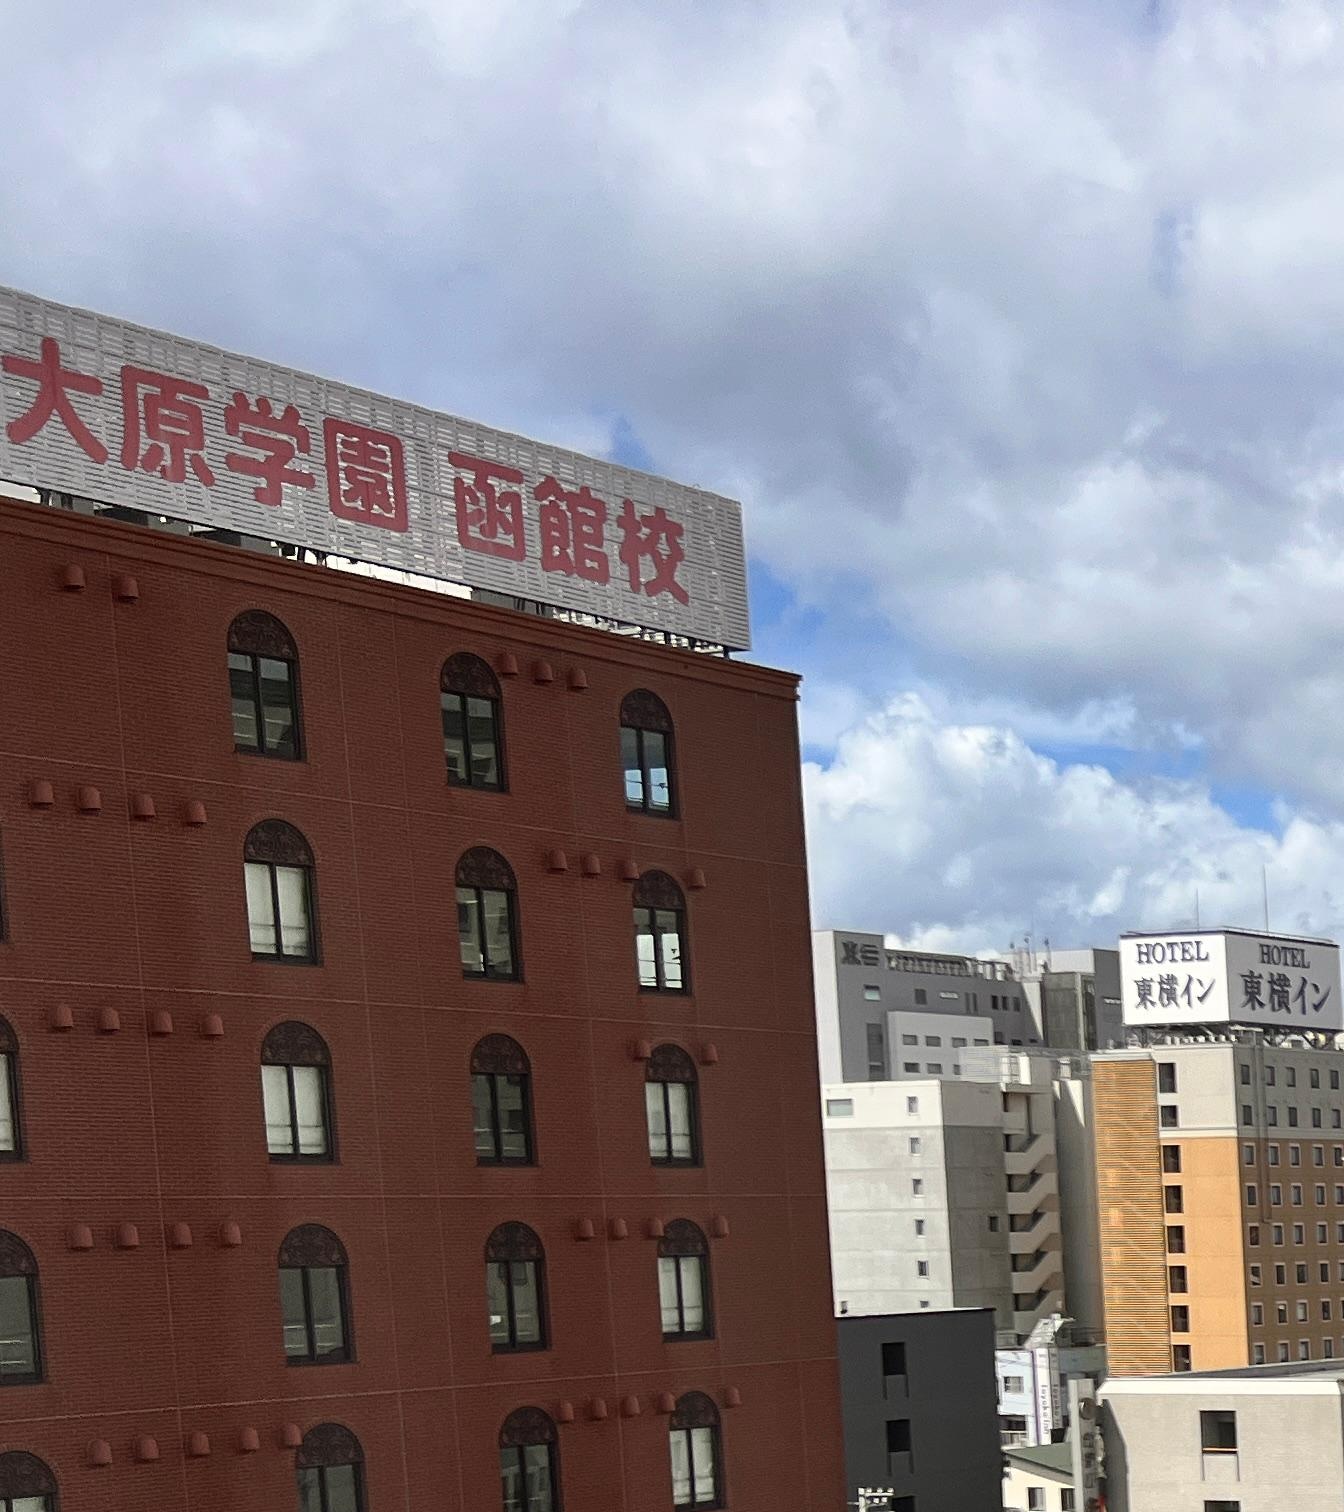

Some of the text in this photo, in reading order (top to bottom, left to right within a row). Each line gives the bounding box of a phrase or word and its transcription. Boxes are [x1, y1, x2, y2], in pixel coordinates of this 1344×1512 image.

[2, 337, 689, 605] 大原学園 函館校
[1136, 941, 1208, 964] HOTEL
[1259, 943, 1310, 968] HOTEL
[1134, 974, 1216, 1009] 東横イン
[1240, 970, 1331, 1015] 東横イン
